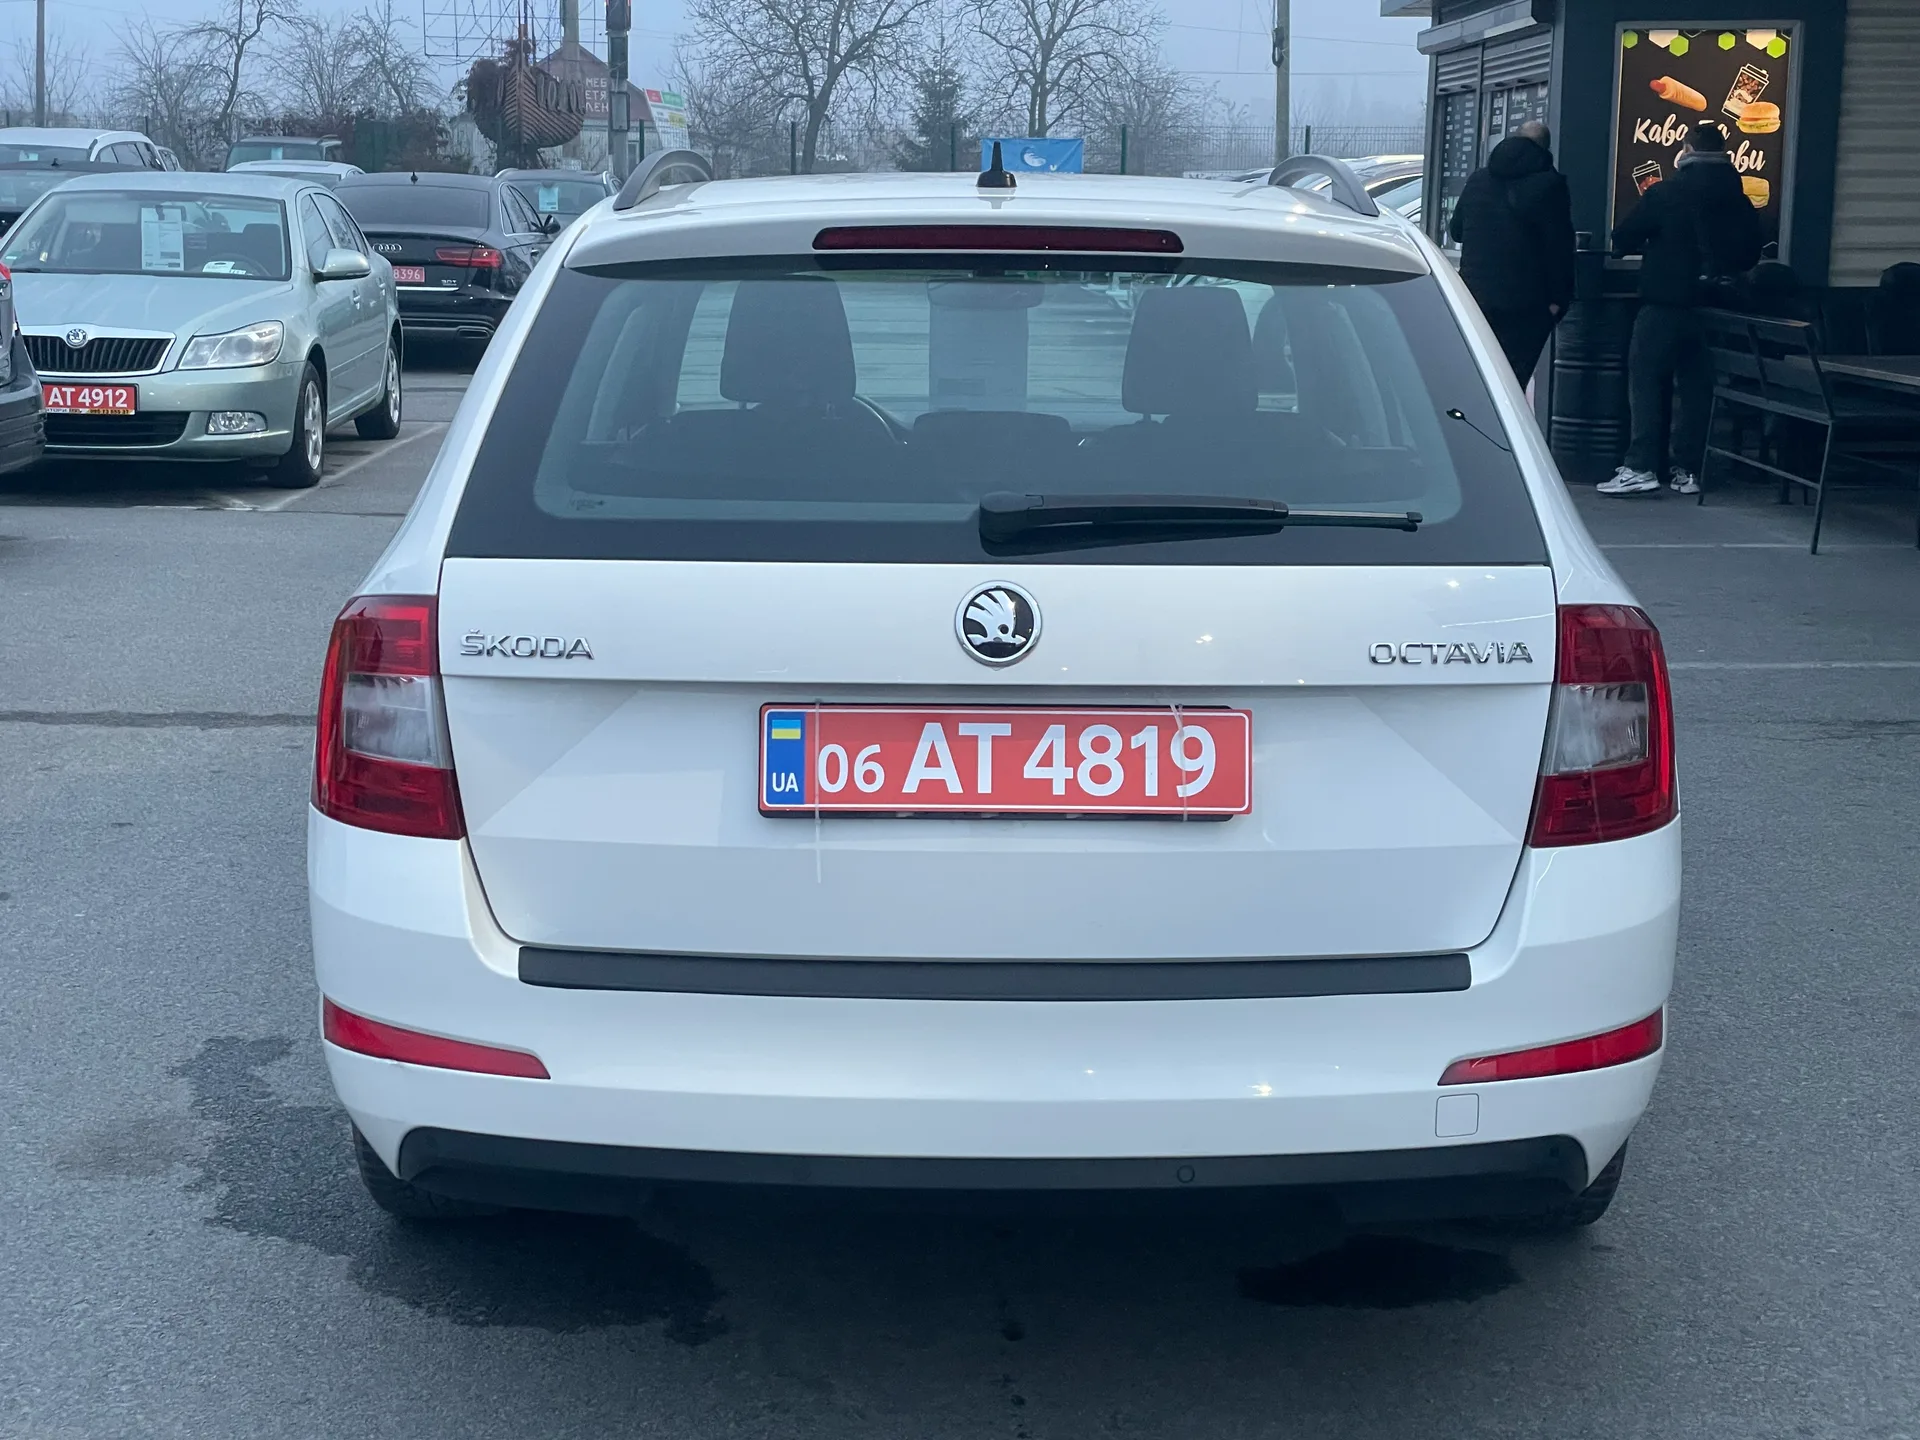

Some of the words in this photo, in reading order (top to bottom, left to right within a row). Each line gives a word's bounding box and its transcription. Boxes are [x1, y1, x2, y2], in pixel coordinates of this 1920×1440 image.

[585, 77, 608, 88] МЕБ
[1633, 113, 1689, 147] Кава
[393, 268, 421, 281] 8396
[48, 387, 76, 406] AT
[77, 388, 128, 408] 4912
[460, 629, 595, 660] ŠKODA
[1369, 641, 1534, 666] OCTAVIA
[817, 743, 886, 793] 06
[902, 722, 1012, 794] AT
[1023, 724, 1217, 798] 4819
[772, 772, 799, 793] UA
